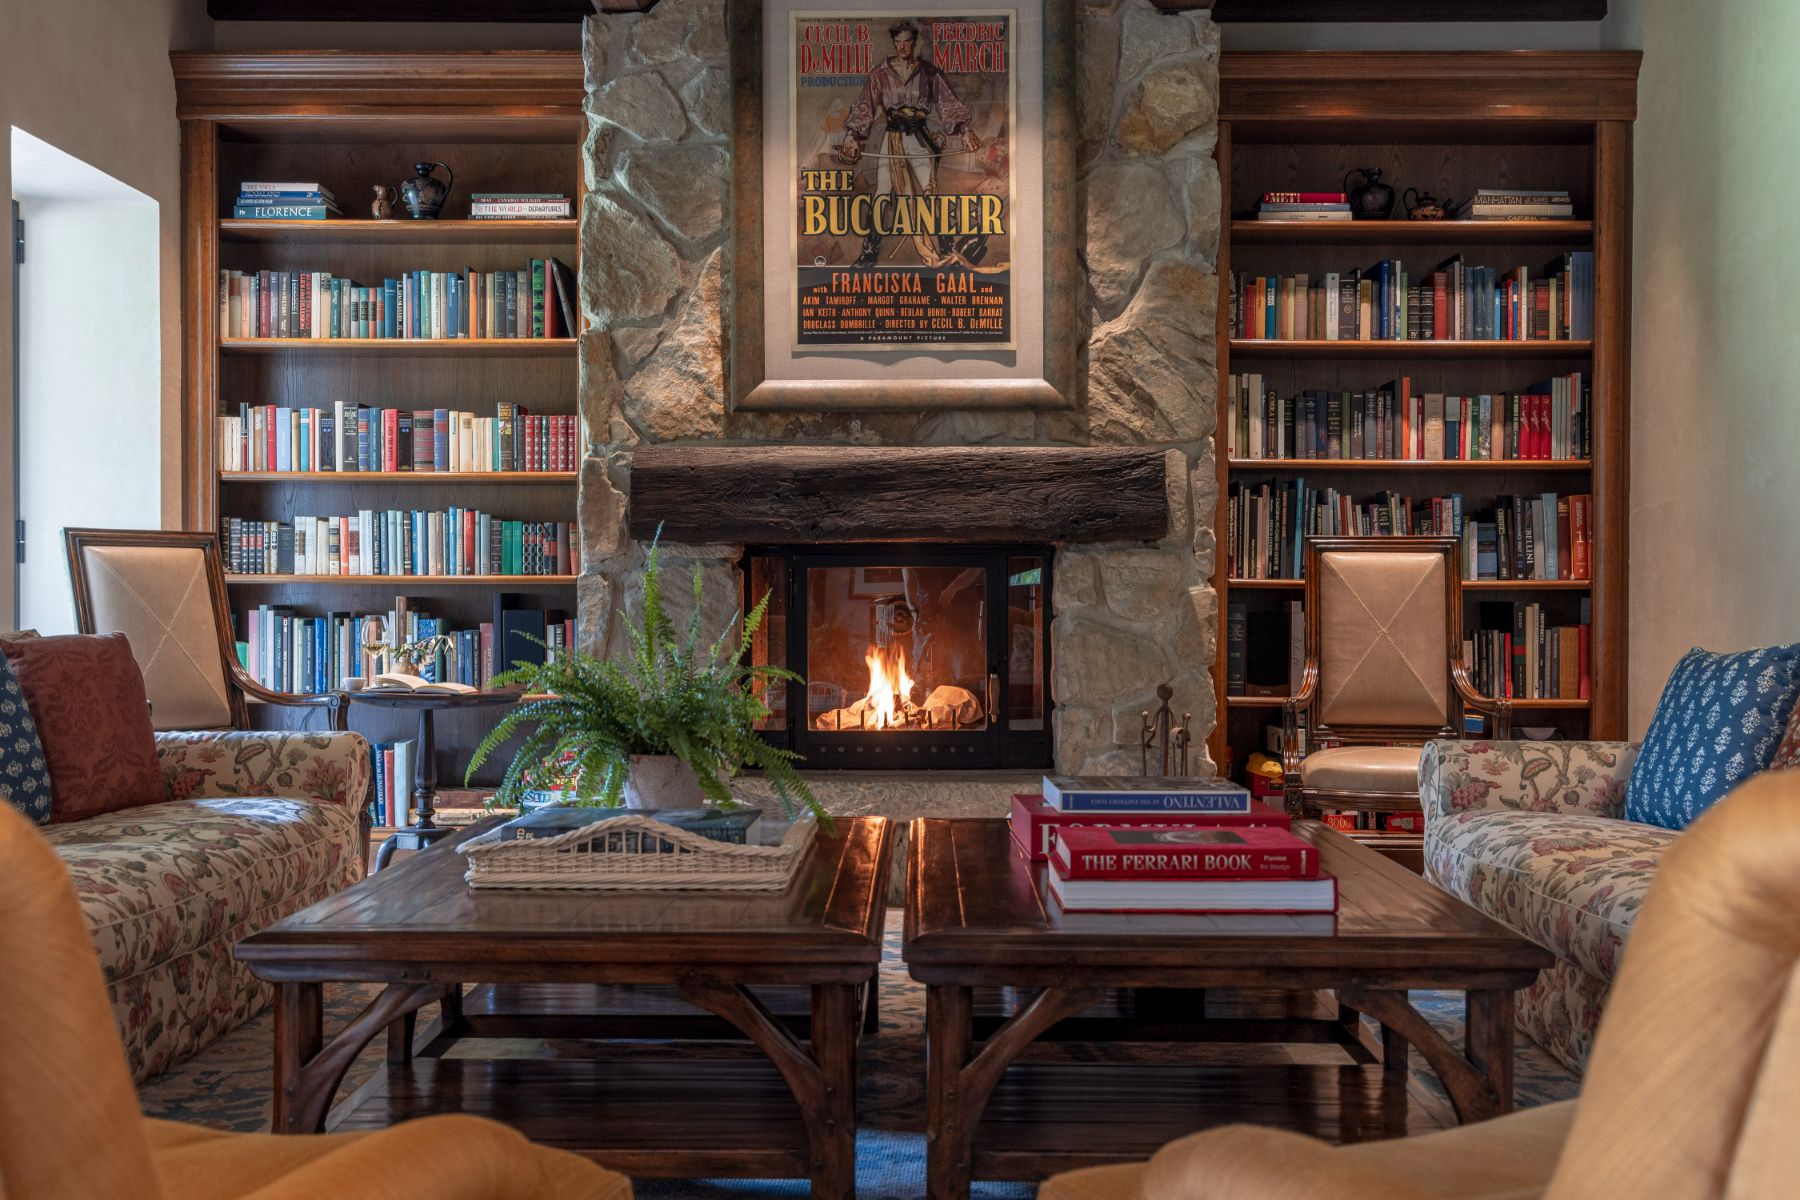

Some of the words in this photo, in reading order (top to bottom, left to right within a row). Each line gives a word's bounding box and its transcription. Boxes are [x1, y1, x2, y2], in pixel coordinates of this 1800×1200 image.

[804, 23, 852, 43] CECIL
[857, 23, 873, 43] B.
[932, 23, 1004, 42] FREDRIC
[800, 43, 874, 75] DeMILLE
[933, 42, 1006, 72] MARCH
[802, 170, 853, 192] THE
[1474, 196, 1522, 205] MANHATTAN
[255, 207, 312, 217] FLORENCE
[803, 194, 1005, 236] BUCCANEER
[832, 272, 922, 293] FRANCISKA
[936, 272, 976, 293] GAAL
[980, 285, 993, 293] and
[802, 296, 820, 305] AKIM
[826, 296, 856, 305] TAMIROFF
[868, 296, 894, 305] MARGOT
[899, 296, 930, 305] GRAHAME
[941, 296, 967, 305] WALTER
[972, 296, 1003, 305] BRENNAN
[802, 308, 814, 317] IAN
[818, 308, 836, 317] KEITH
[841, 308, 872, 317] ANTHONY
[875, 308, 895, 318] QUINN
[900, 308, 924, 317] BEULAH
[927, 308, 946, 317] BONDI
[951, 308, 975, 317] ROBERT
[979, 308, 1003, 317] BARRAT
[803, 319, 836, 329] DOUGLASS
[840, 319, 876, 329] DUMBRILLE
[885, 319, 915, 329] DIRECTED
[919, 319, 928, 329] BY
[931, 318, 953, 329] CECIL
[957, 318, 966, 329] B.
[1525, 530, 1533, 564] BELLINI
[1163, 796, 1241, 809] VALENTINO
[1082, 854, 1116, 871] THE
[1122, 854, 1198, 871] FERRARI
[1204, 854, 1252, 871] BOOK
